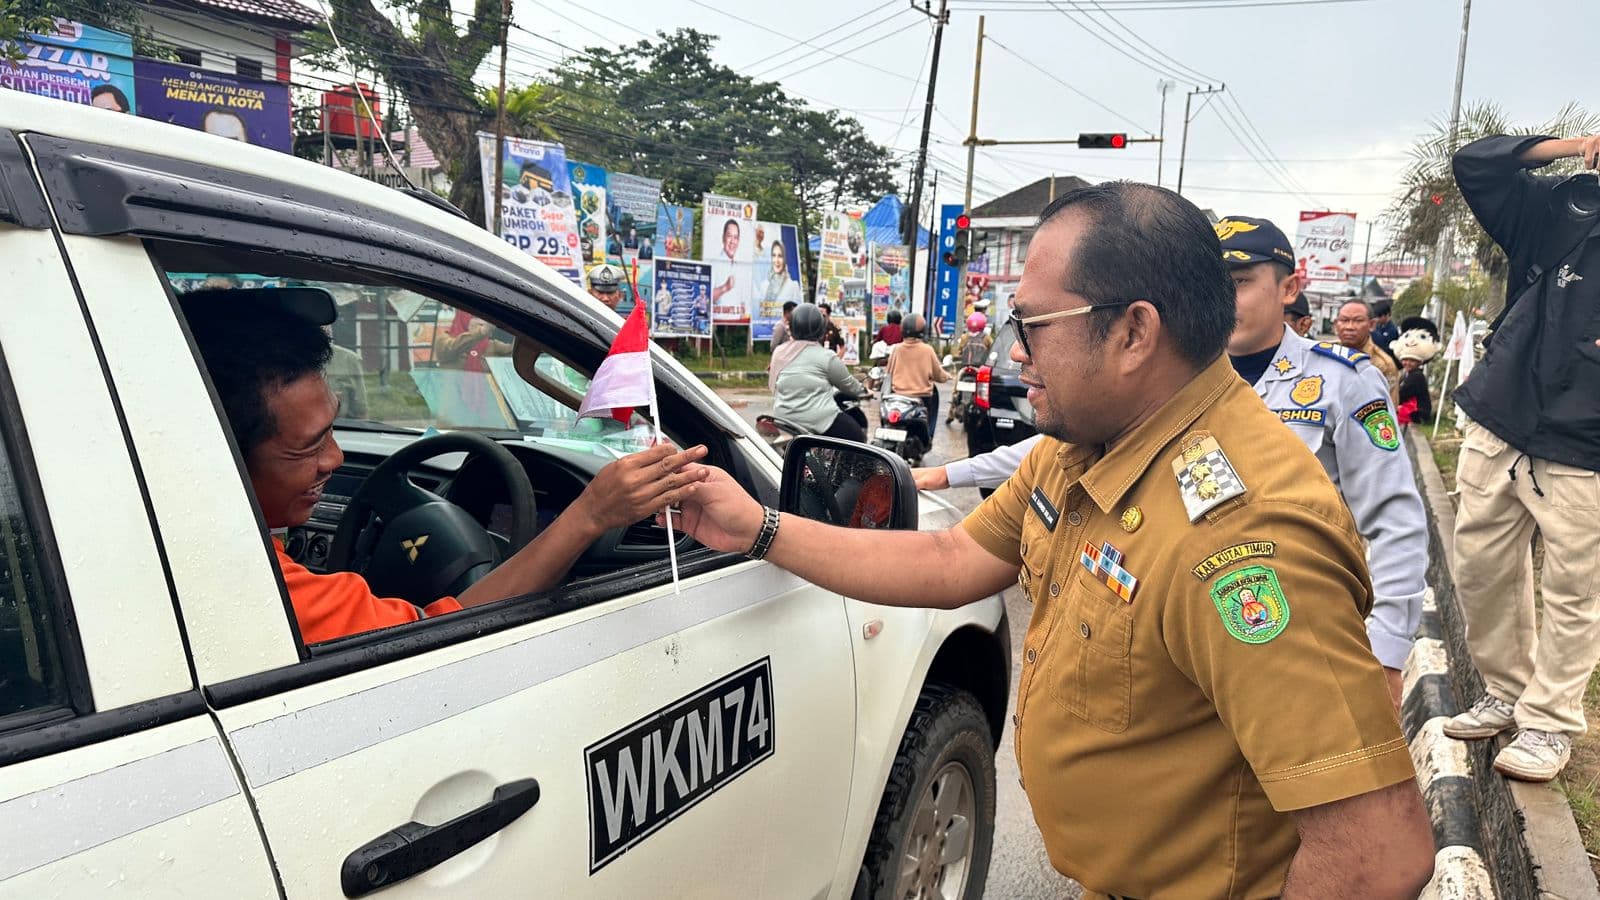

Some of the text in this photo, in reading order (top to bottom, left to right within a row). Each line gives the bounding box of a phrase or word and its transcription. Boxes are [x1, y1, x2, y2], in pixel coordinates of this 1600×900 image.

[162, 77, 236, 95] MEMBANGUN
[238, 88, 265, 100] DESA
[166, 87, 263, 110] MENATA KOTA
[502, 206, 536, 219] PAKET
[504, 218, 545, 231] UMROH
[537, 236, 559, 255] 29
[941, 218, 956, 317] POISI
[1216, 547, 1243, 565] KUTAI
[1244, 544, 1272, 555] TIMUR
[595, 676, 769, 844] WKM74
